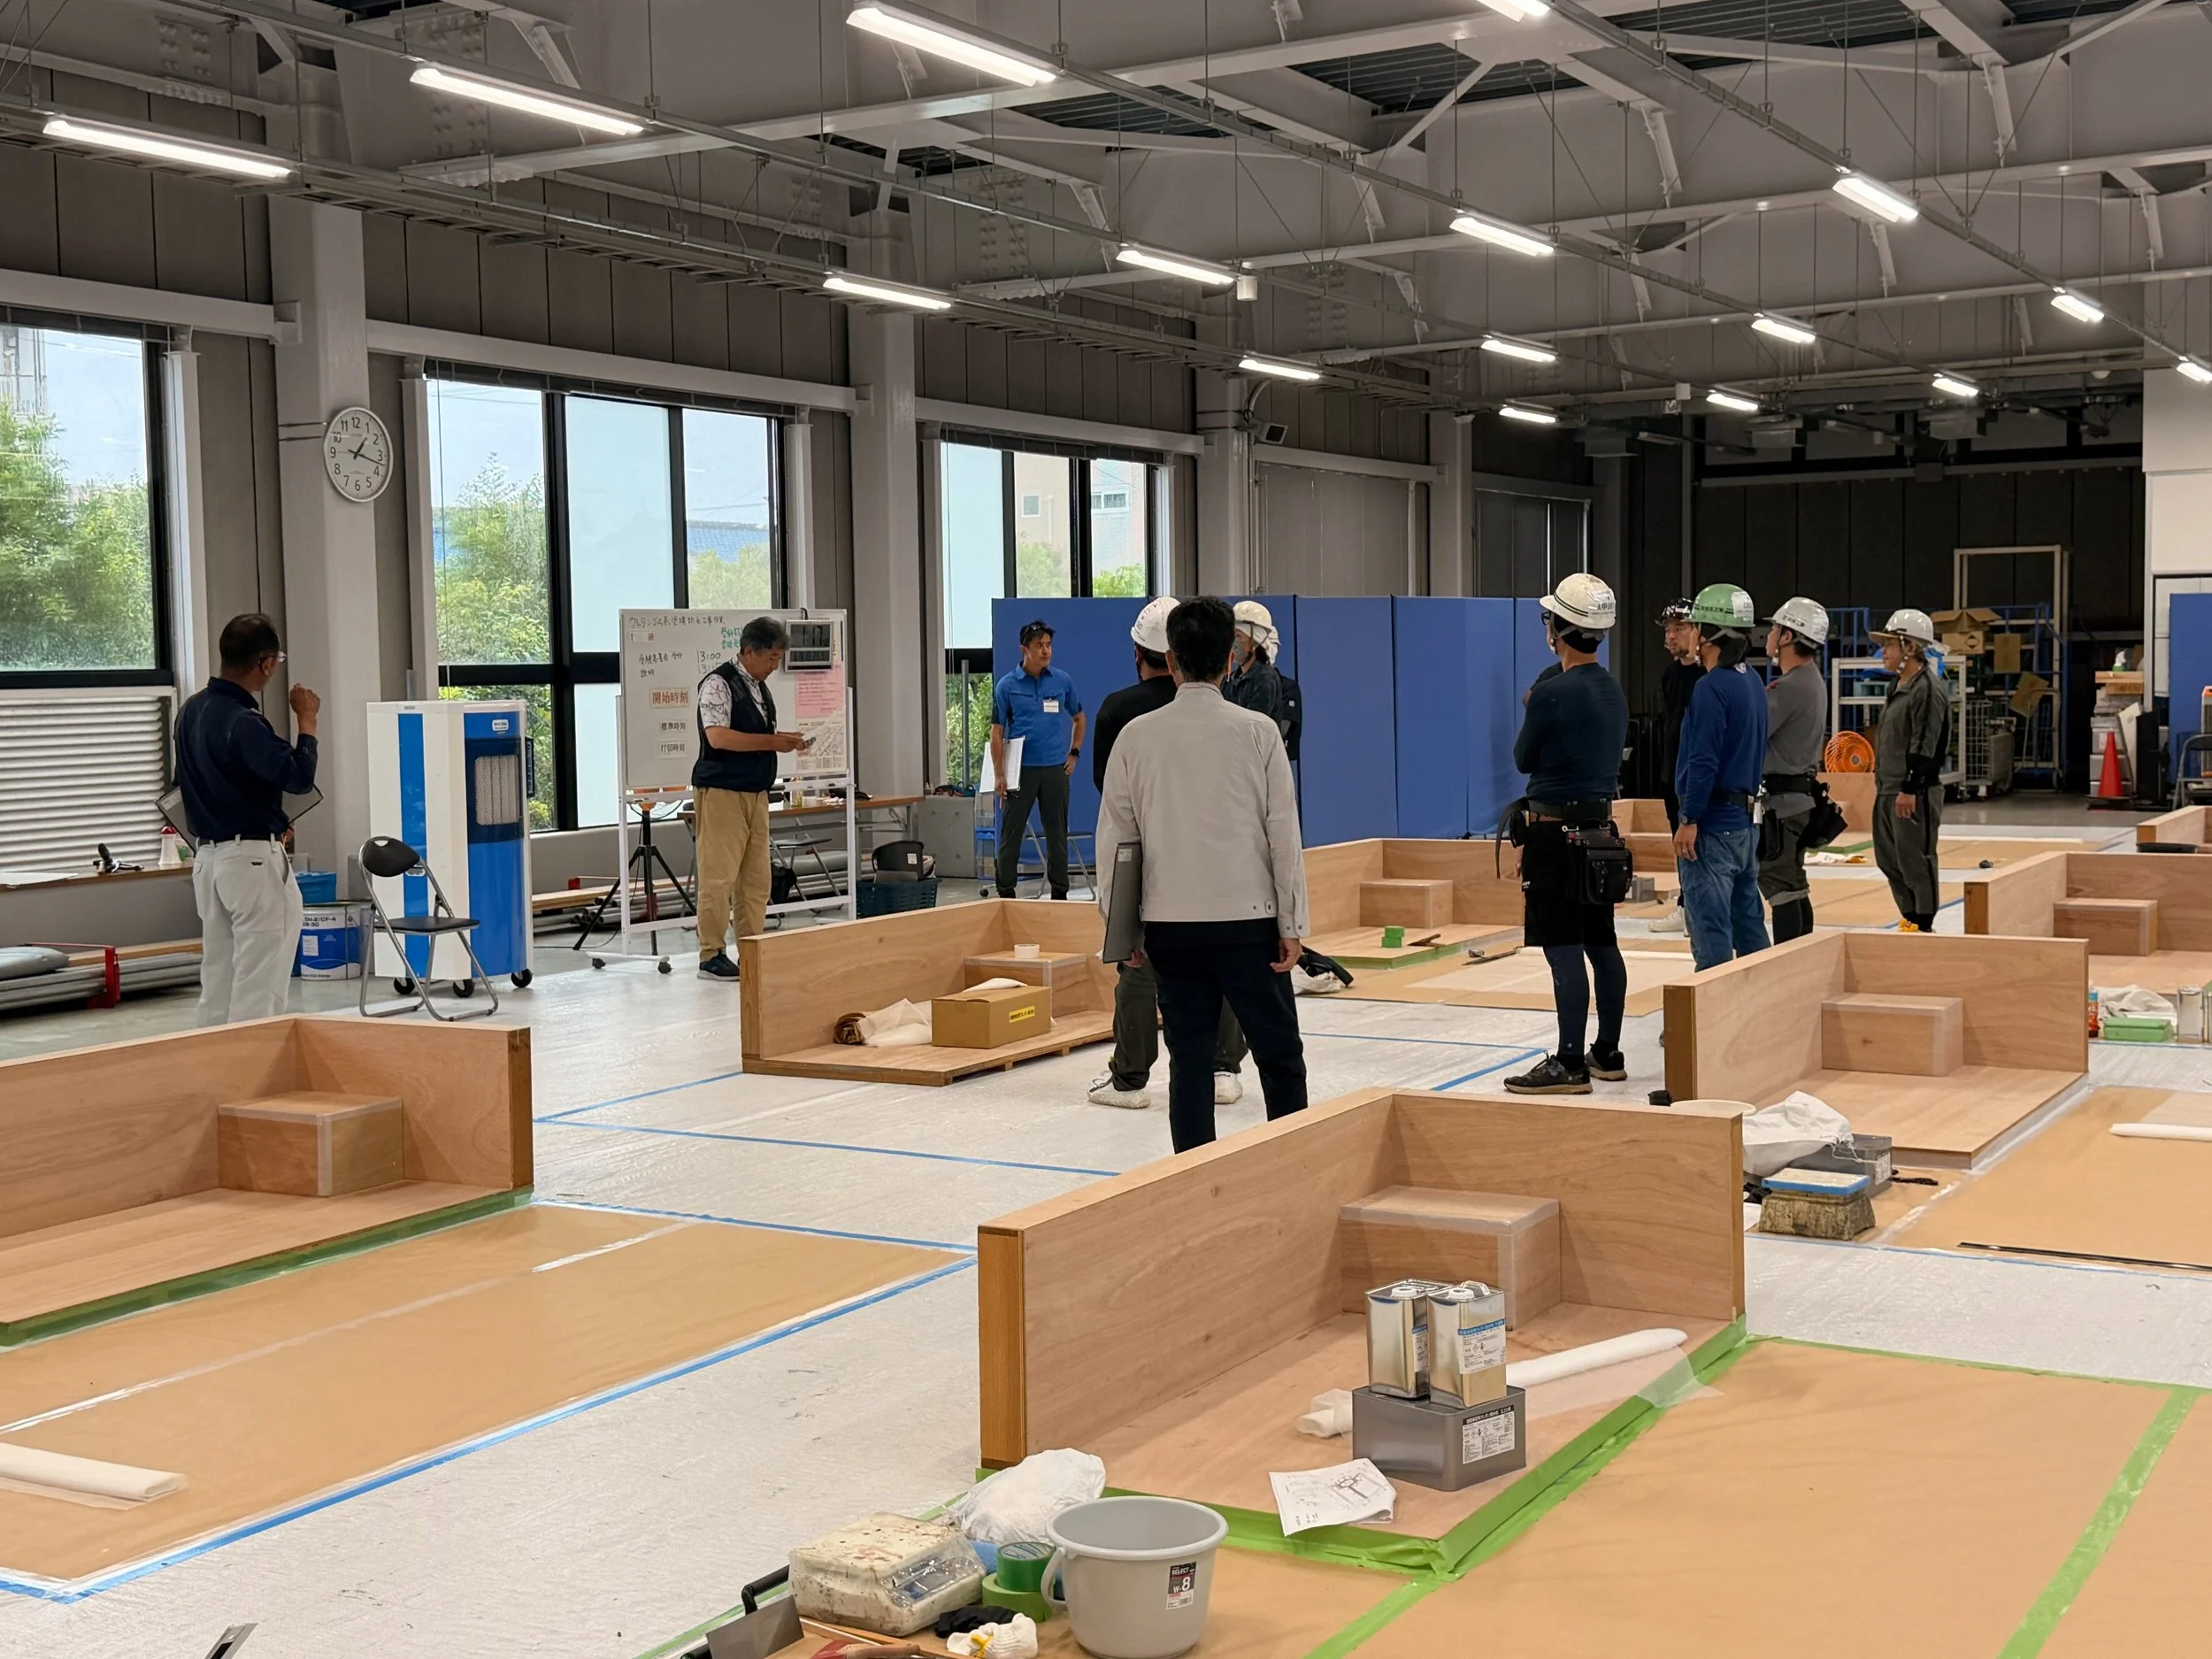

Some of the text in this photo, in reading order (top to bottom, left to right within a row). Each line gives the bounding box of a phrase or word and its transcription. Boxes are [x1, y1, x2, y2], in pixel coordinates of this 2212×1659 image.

[341, 420, 348, 432] 11
[351, 417, 361, 429] 12
[365, 422, 370, 434] 1
[331, 431, 342, 443] 10
[373, 433, 379, 445] 2
[330, 446, 336, 459] 9
[377, 449, 383, 461] 3
[334, 463, 341, 475] 8
[373, 465, 380, 476] 4
[343, 475, 349, 487] 7
[354, 480, 361, 491] 6
[366, 476, 372, 488] 5
[696, 650, 721, 662] 13:00
[652, 691, 688, 705] 開始時刻
[661, 722, 686, 731] 標準時刻
[661, 743, 685, 753] 打切時刻
[1171, 1567, 1190, 1575] SELECT
